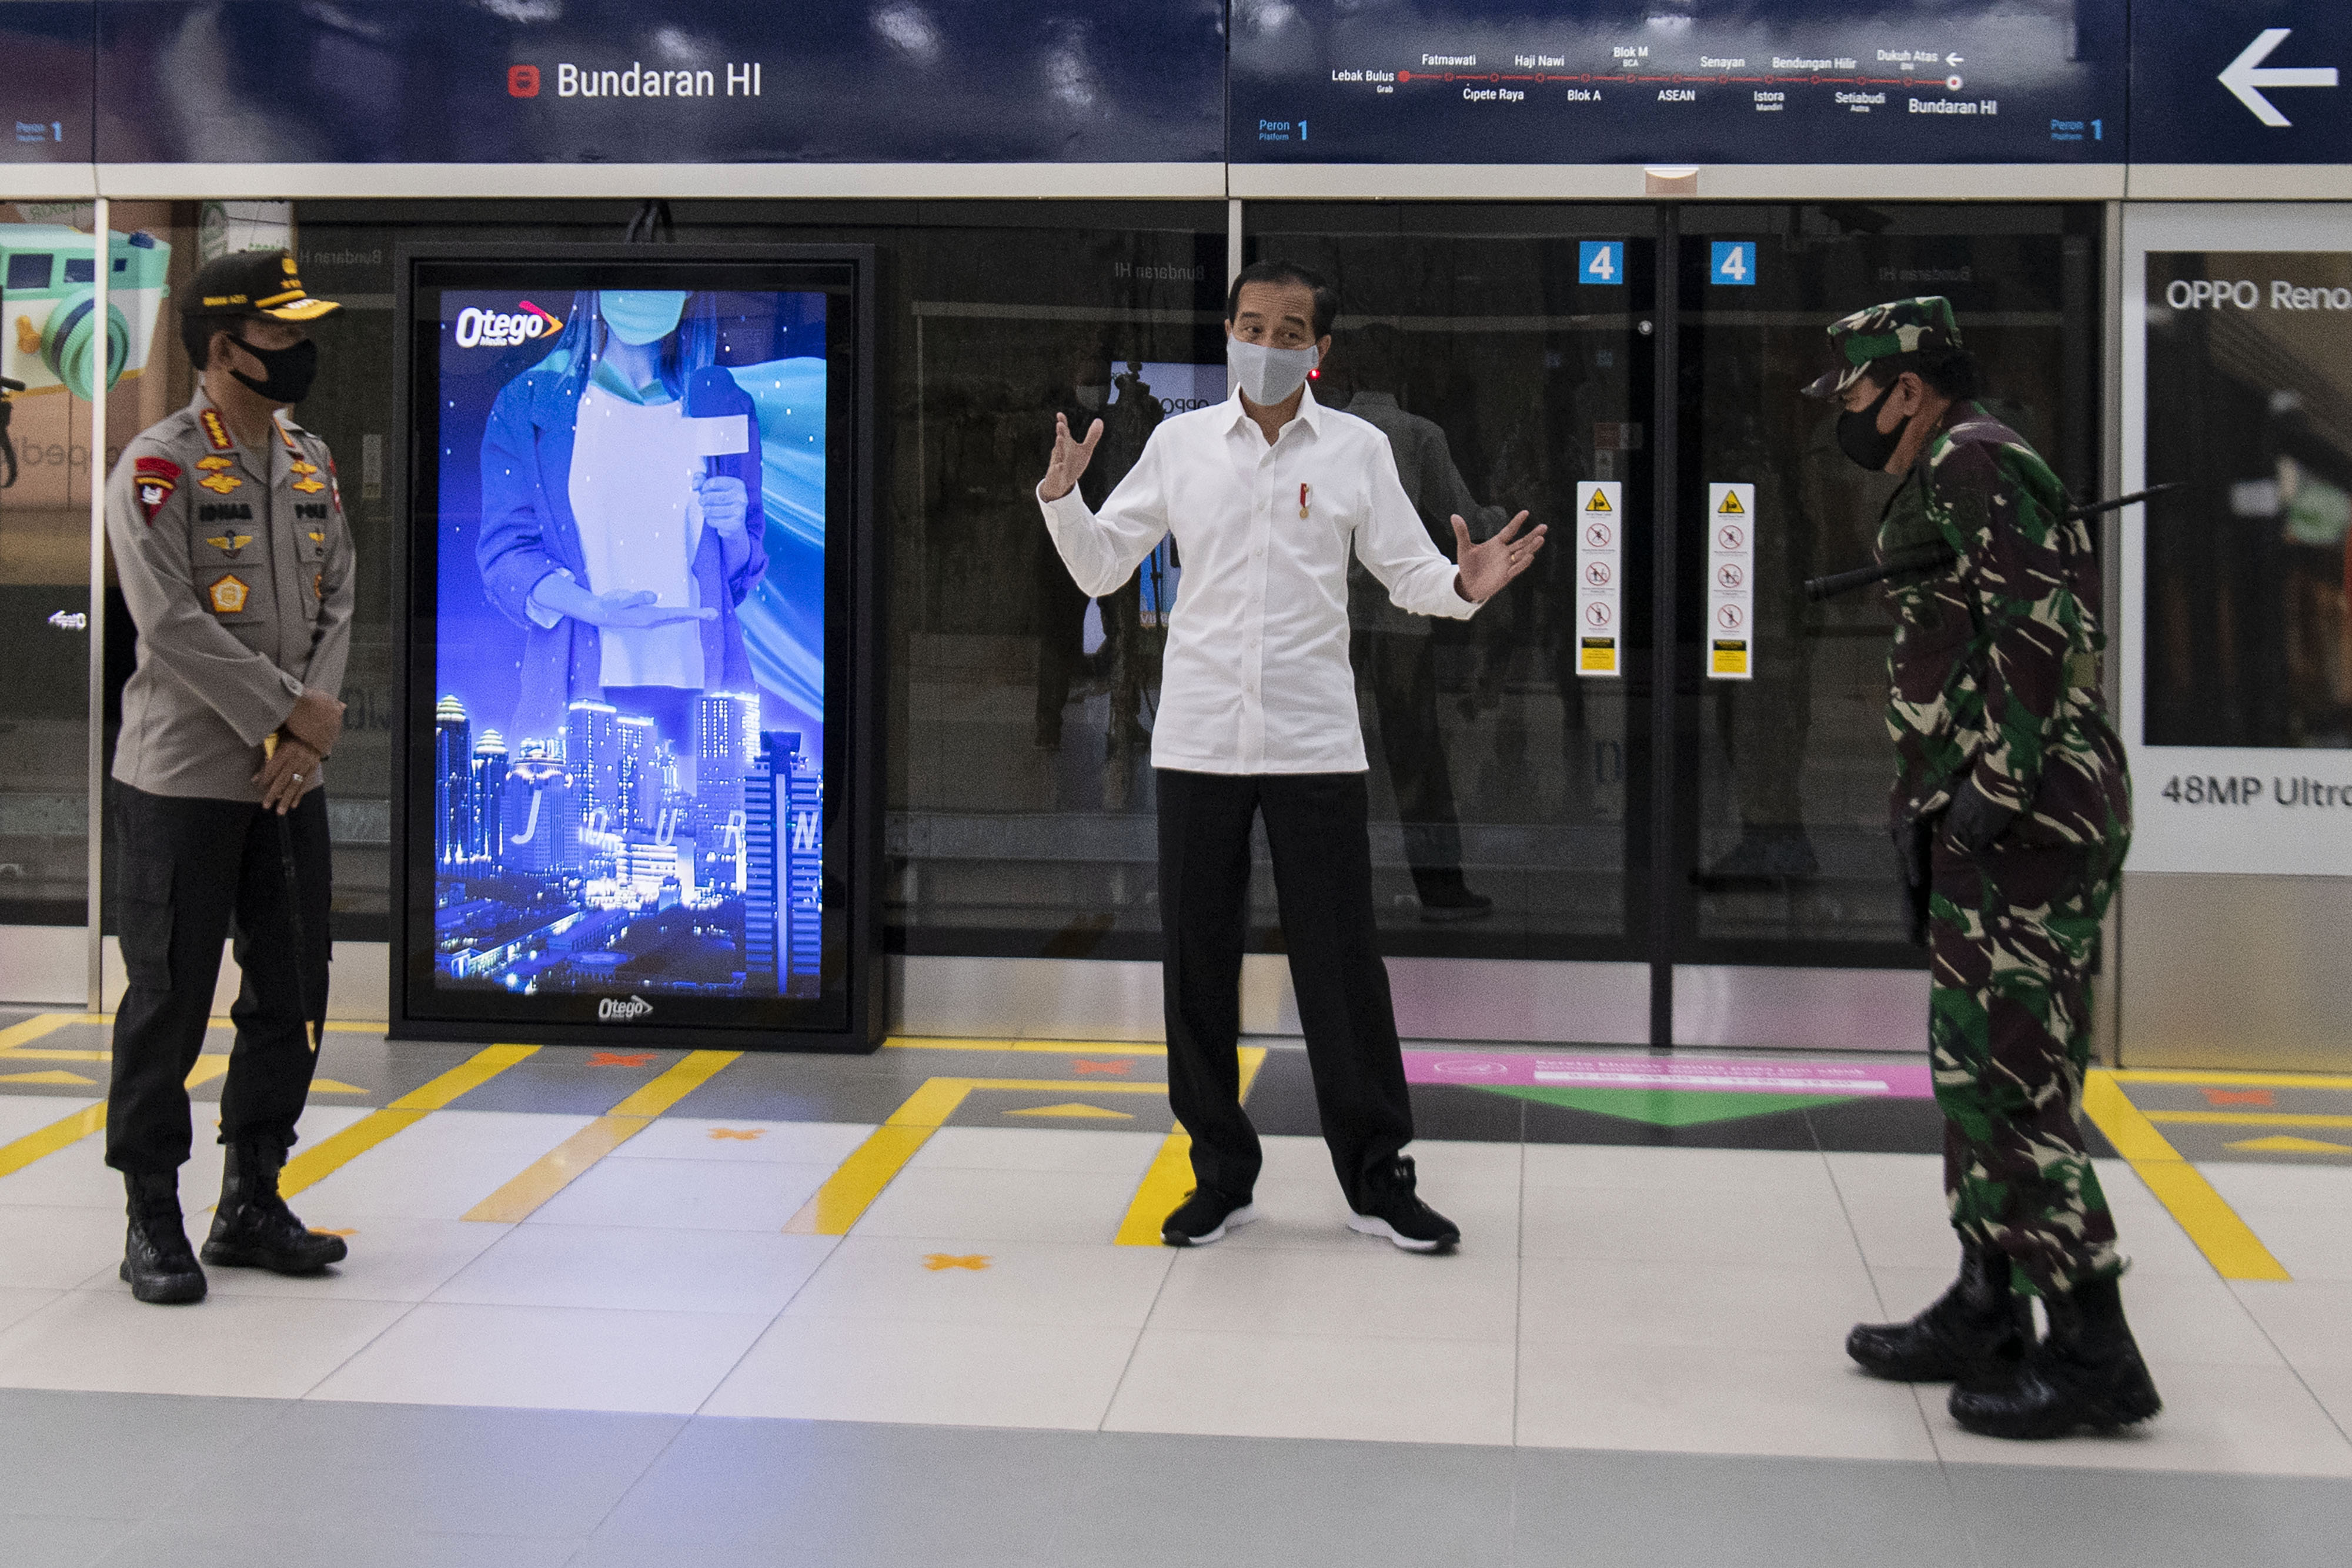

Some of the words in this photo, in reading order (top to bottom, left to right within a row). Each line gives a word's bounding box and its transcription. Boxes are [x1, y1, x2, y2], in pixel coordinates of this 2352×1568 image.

[1614, 46, 1636, 57] Blok
[1638, 47, 1648, 57] M
[1877, 49, 1910, 62] Dukuh
[1913, 51, 1939, 62] Atas
[1422, 54, 1476, 66] Fatmawati
[1515, 55, 1535, 68] Haji
[1538, 55, 1565, 66] Nawi
[1700, 57, 1745, 69] Senayan
[1772, 57, 1830, 71] Bendungan
[1833, 58, 1856, 69] Hilir
[558, 62, 714, 97] Bundaran
[727, 63, 761, 96] HI
[1332, 70, 1363, 82] Lebak
[1367, 70, 1394, 82] Bulus
[1377, 85, 1394, 93] Grab
[1464, 86, 1496, 101] Cipete
[1499, 89, 1524, 101] Raya
[1568, 89, 1591, 101] Blok
[1593, 90, 1601, 101] A
[1658, 90, 1695, 101] ASEAN
[1754, 91, 1784, 102] Istora
[1835, 92, 1885, 105] Setiabudi
[1909, 99, 1977, 115] Bundaran
[1980, 101, 1997, 115] HI
[51, 121, 62, 142] 1
[1259, 119, 1289, 131] Peron
[1298, 120, 1307, 140] 1
[2090, 118, 2103, 141] 1
[1259, 132, 1289, 141] Platform
[1589, 247, 1614, 279] 4
[1721, 246, 1746, 280] 4
[2167, 280, 2259, 310] OPPO
[2271, 281, 2350, 310] Reno
[456, 307, 543, 348] Otego
[480, 337, 507, 347] Media
[2161, 775, 2261, 805] 48MP
[599, 998, 643, 1019] Otego
